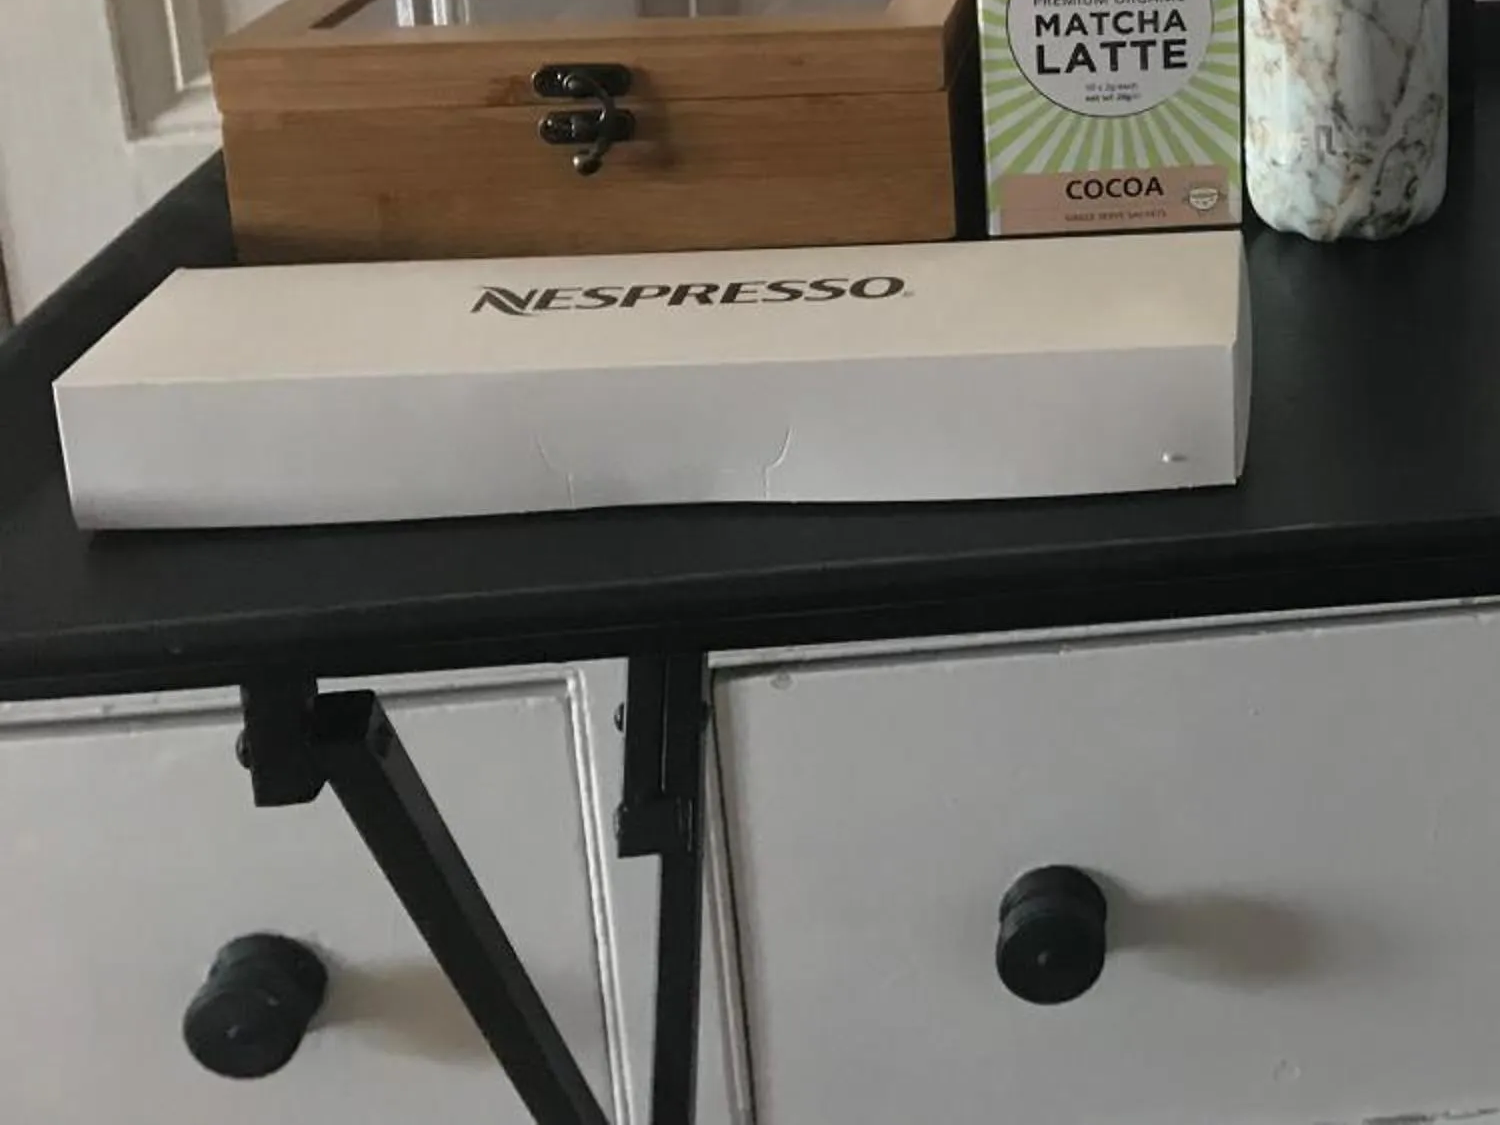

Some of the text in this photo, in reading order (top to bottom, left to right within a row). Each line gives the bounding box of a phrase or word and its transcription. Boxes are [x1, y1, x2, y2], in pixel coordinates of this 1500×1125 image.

[1034, 8, 1187, 37] MATCHA
[1036, 38, 1188, 75] LATTE
[1065, 176, 1165, 200] COCOA
[471, 276, 905, 316] NESPRESSO
